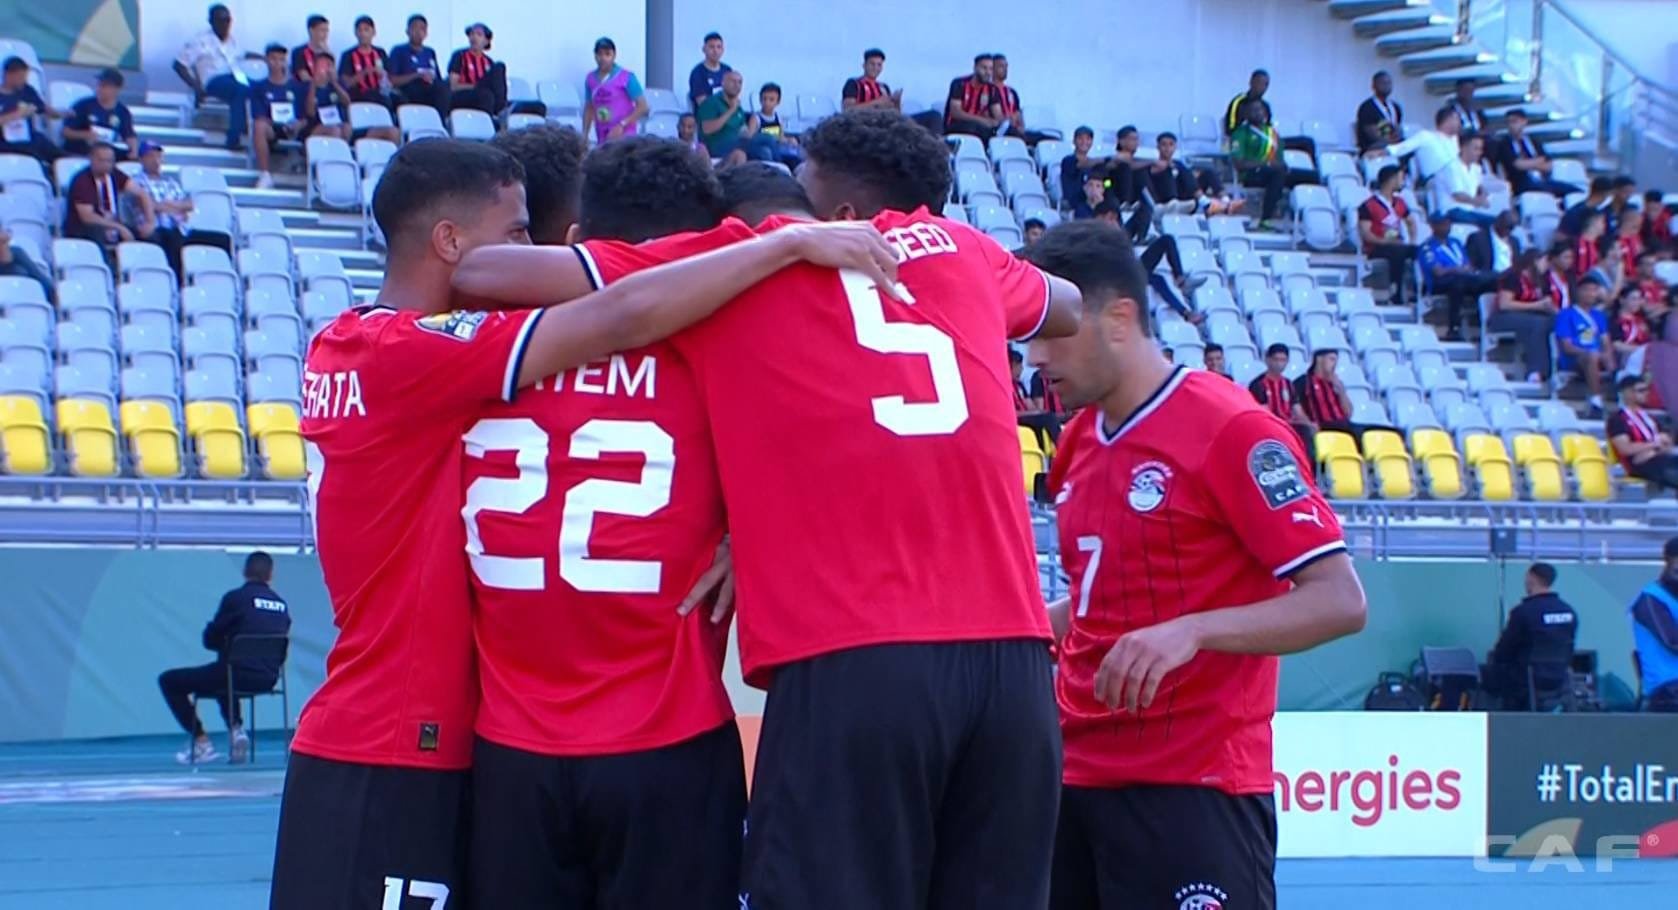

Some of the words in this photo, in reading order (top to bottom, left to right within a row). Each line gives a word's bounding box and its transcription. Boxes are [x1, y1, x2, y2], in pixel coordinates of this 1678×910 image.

[838, 268, 970, 436] 5
[461, 417, 676, 593] 22
[1076, 536, 1104, 618] 7
